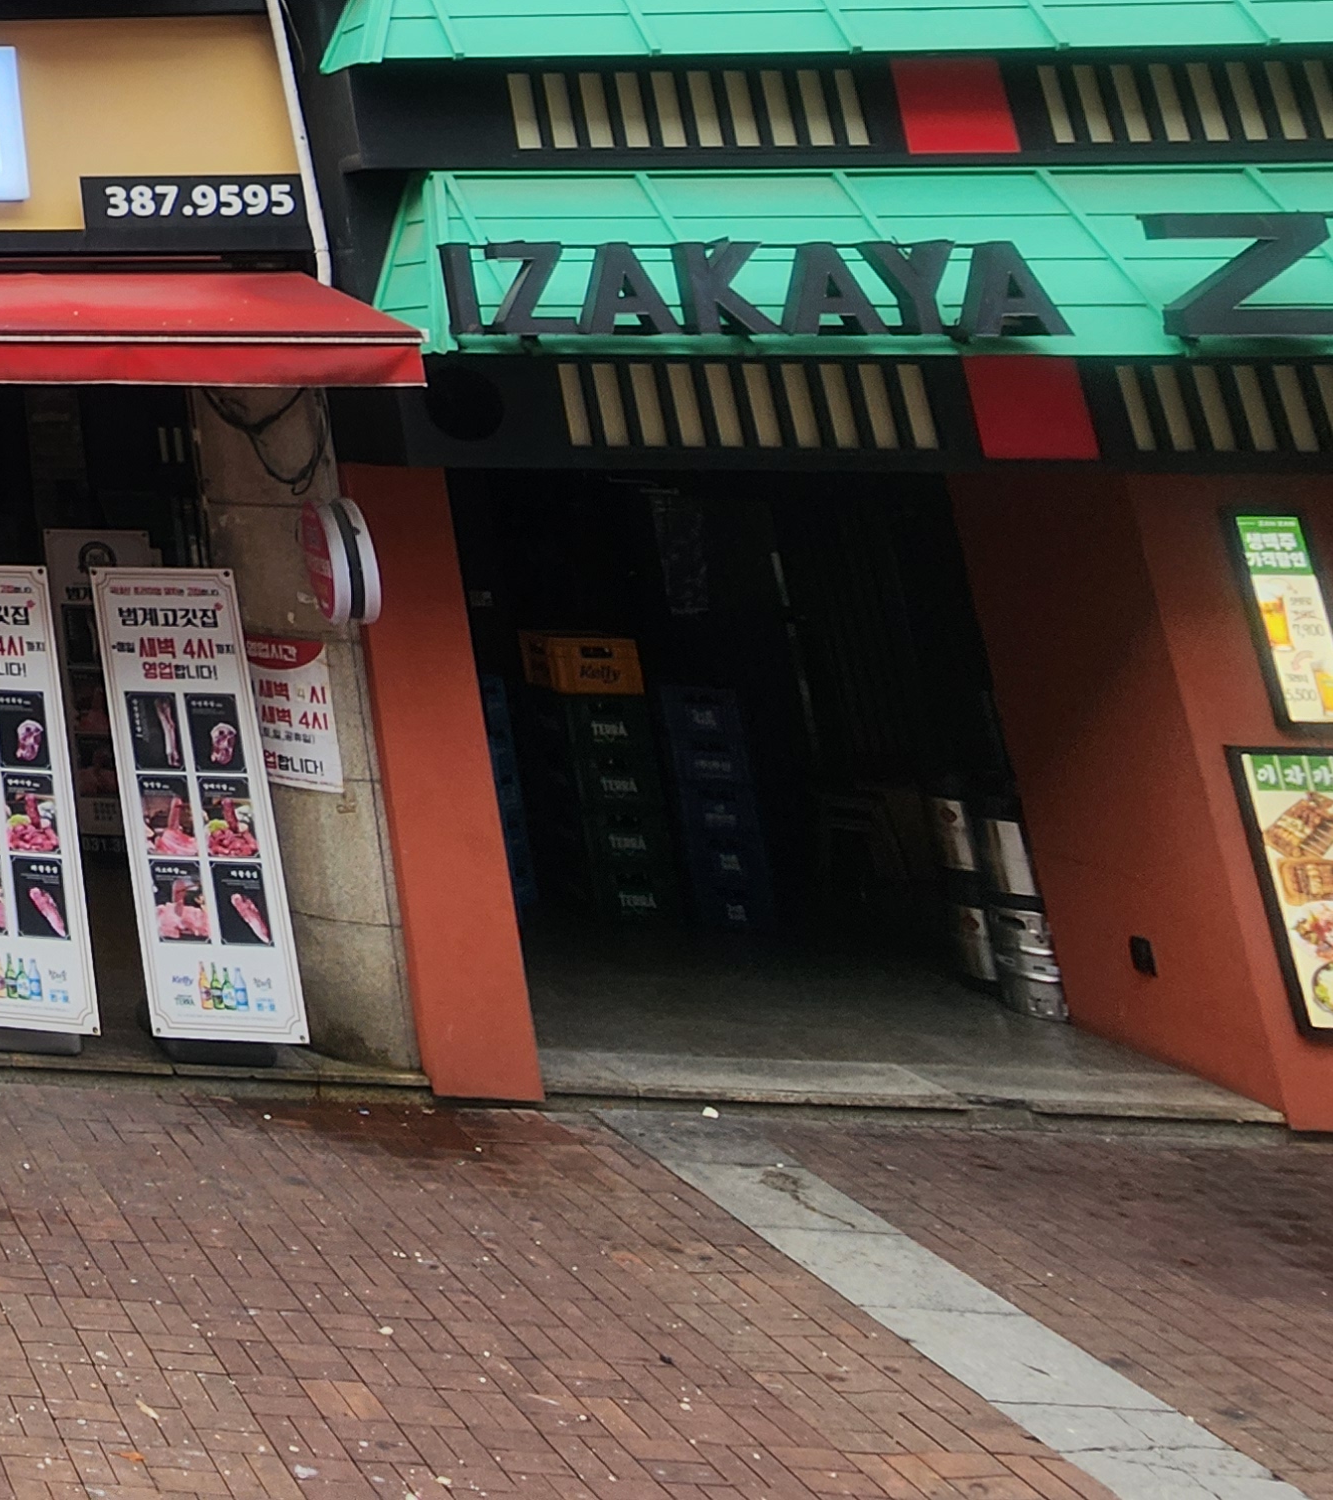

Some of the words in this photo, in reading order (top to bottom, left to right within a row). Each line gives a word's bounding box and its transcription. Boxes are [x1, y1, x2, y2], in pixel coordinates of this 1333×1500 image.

[103, 182, 297, 221] 387.9595
[436, 236, 1076, 338] IZAKAYA
[118, 606, 219, 628] 범계고깃집
[139, 637, 176, 658] 새벽
[142, 661, 218, 680] 영업합니다!
[579, 663, 622, 684] Kelly
[259, 678, 290, 700] 새벽
[261, 705, 291, 727] 새벽
[299, 711, 328, 730] 4시
[591, 721, 628, 737] TERRA
[264, 750, 325, 775] 업합니다!
[601, 778, 638, 794] TERRA
[609, 835, 647, 851] TERRA
